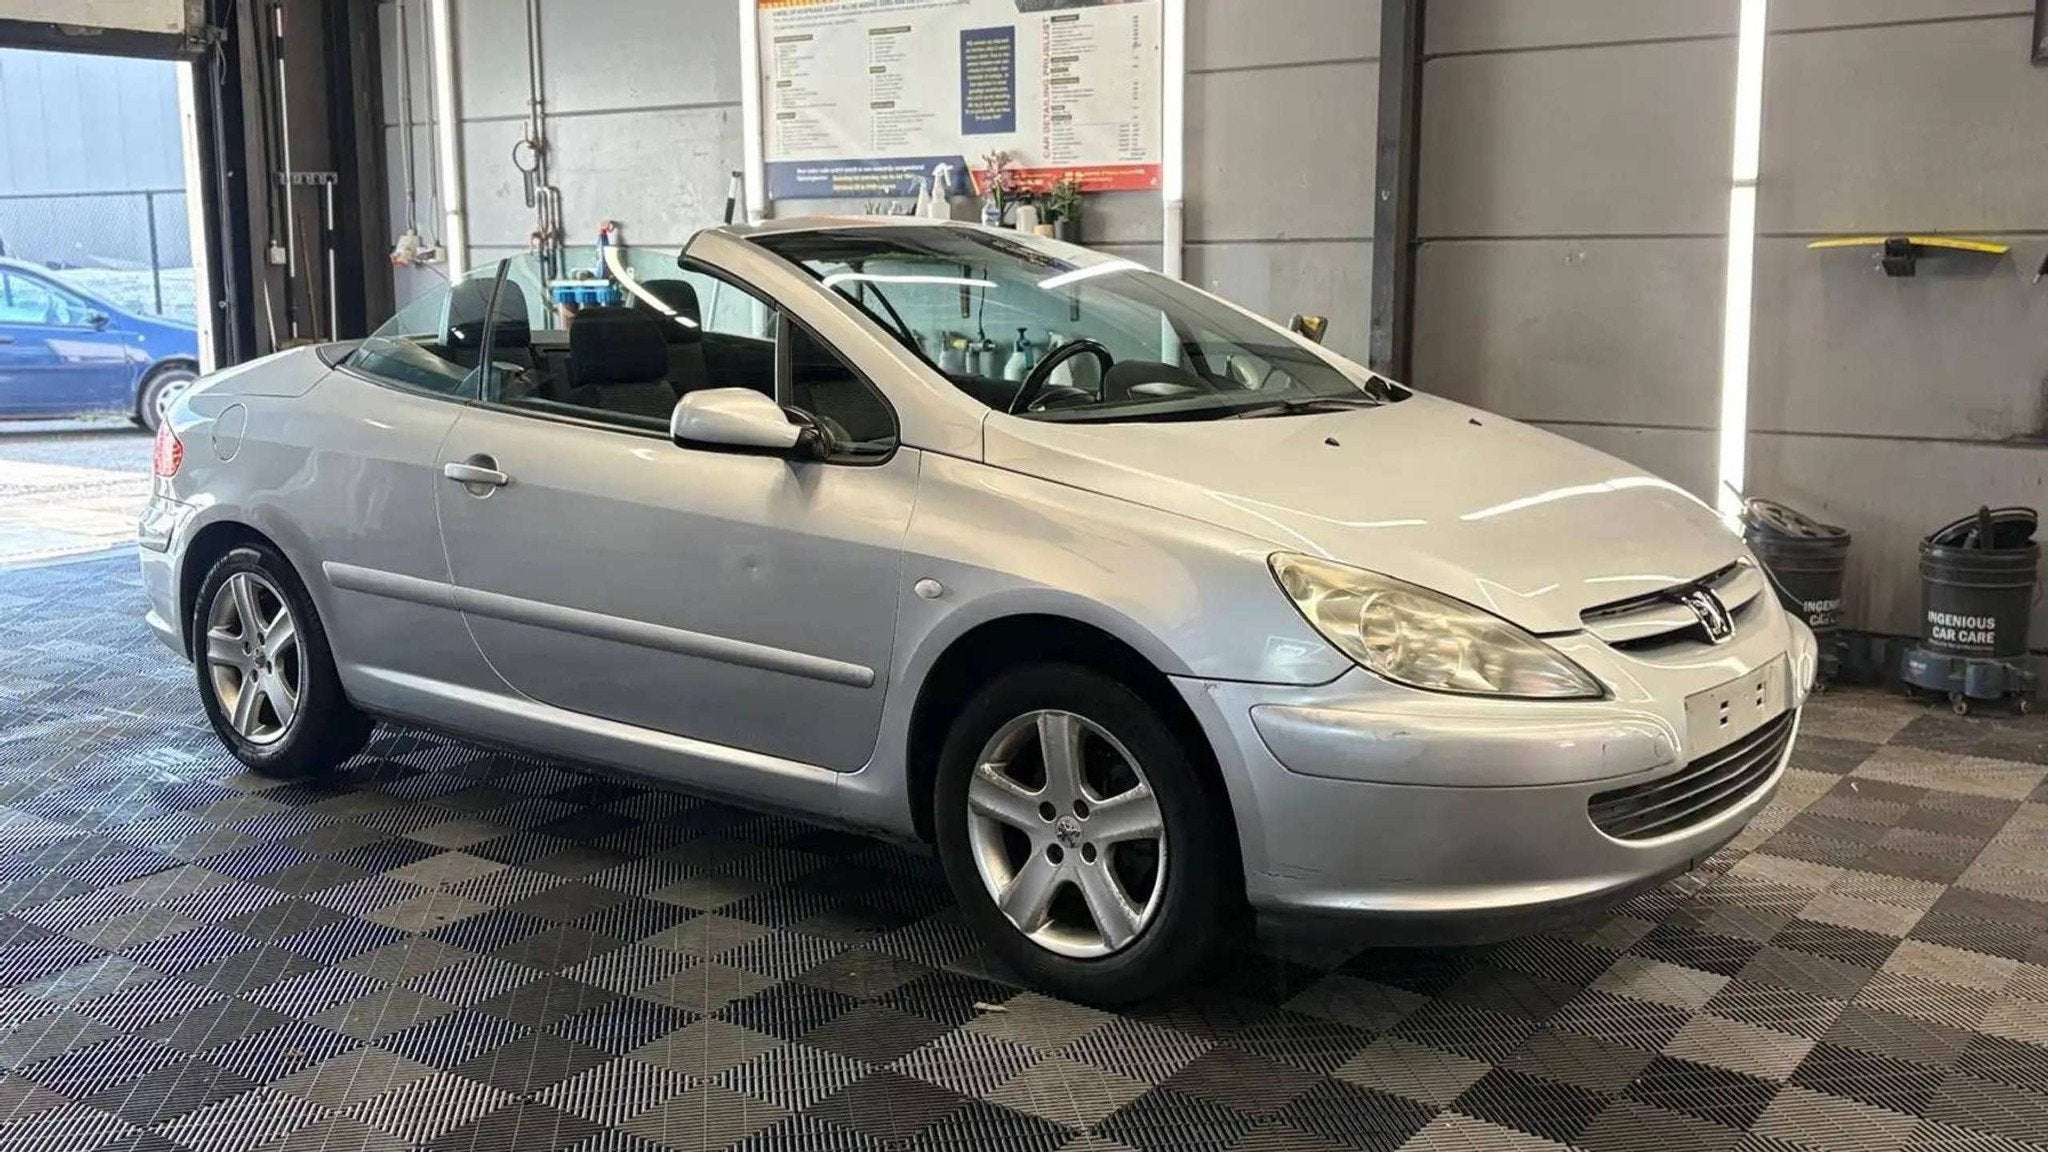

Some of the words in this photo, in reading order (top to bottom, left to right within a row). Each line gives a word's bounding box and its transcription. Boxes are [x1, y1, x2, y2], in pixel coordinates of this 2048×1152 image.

[1043, 137, 1051, 158] CAR
[1928, 610, 1995, 630] INGENIOUS
[1932, 626, 1956, 641] CAR
[1957, 630, 1995, 644] CARE
